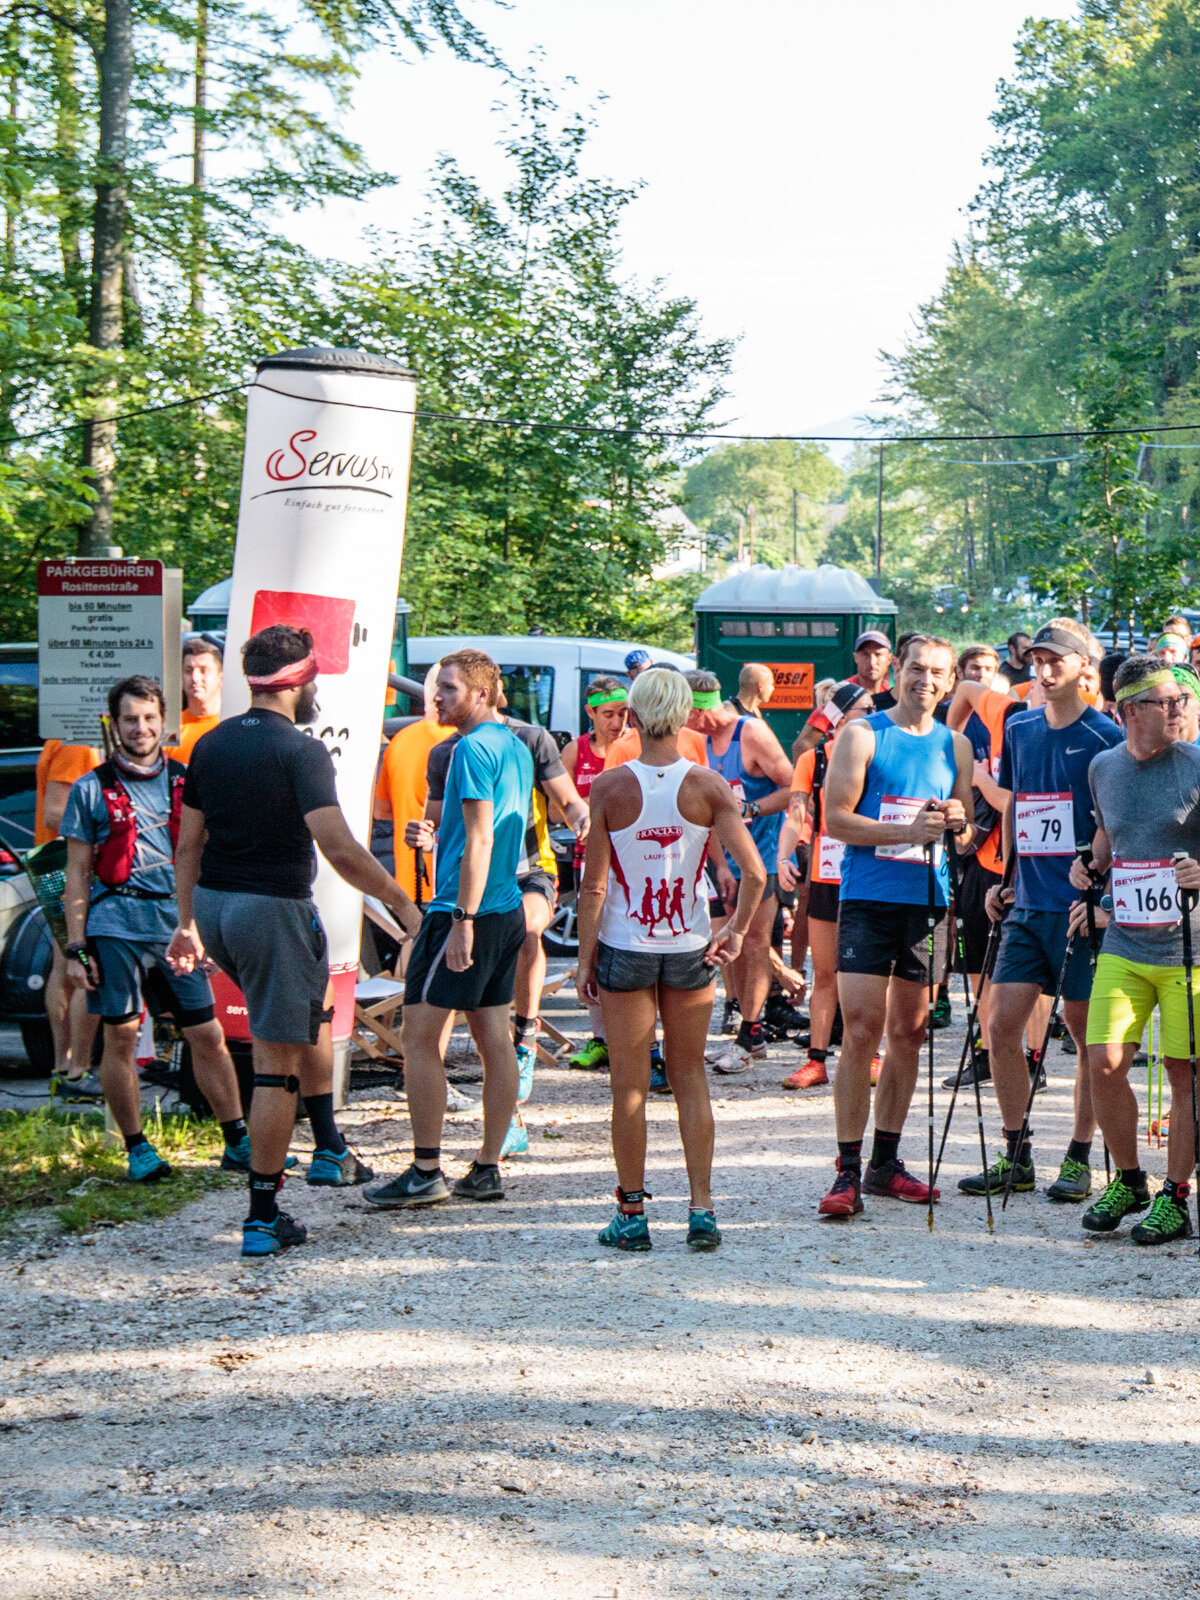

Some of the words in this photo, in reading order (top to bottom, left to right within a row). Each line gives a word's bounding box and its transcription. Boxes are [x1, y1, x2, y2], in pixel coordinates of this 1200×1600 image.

[284, 497, 322, 510] Einfach
[325, 502, 342, 513] gut
[46, 564, 154, 577] PARKGEBÜHREN
[61, 581, 139, 592] Rosittenstraße
[68, 602, 82, 611] bis
[97, 602, 132, 611] Minuten
[87, 614, 113, 623] gratis
[48, 639, 68, 648] über
[82, 639, 118, 648] Minuten
[134, 639, 146, 647] 24
[147, 639, 154, 647] h
[1041, 819, 1062, 842] 79
[1135, 887, 1172, 912] 166
